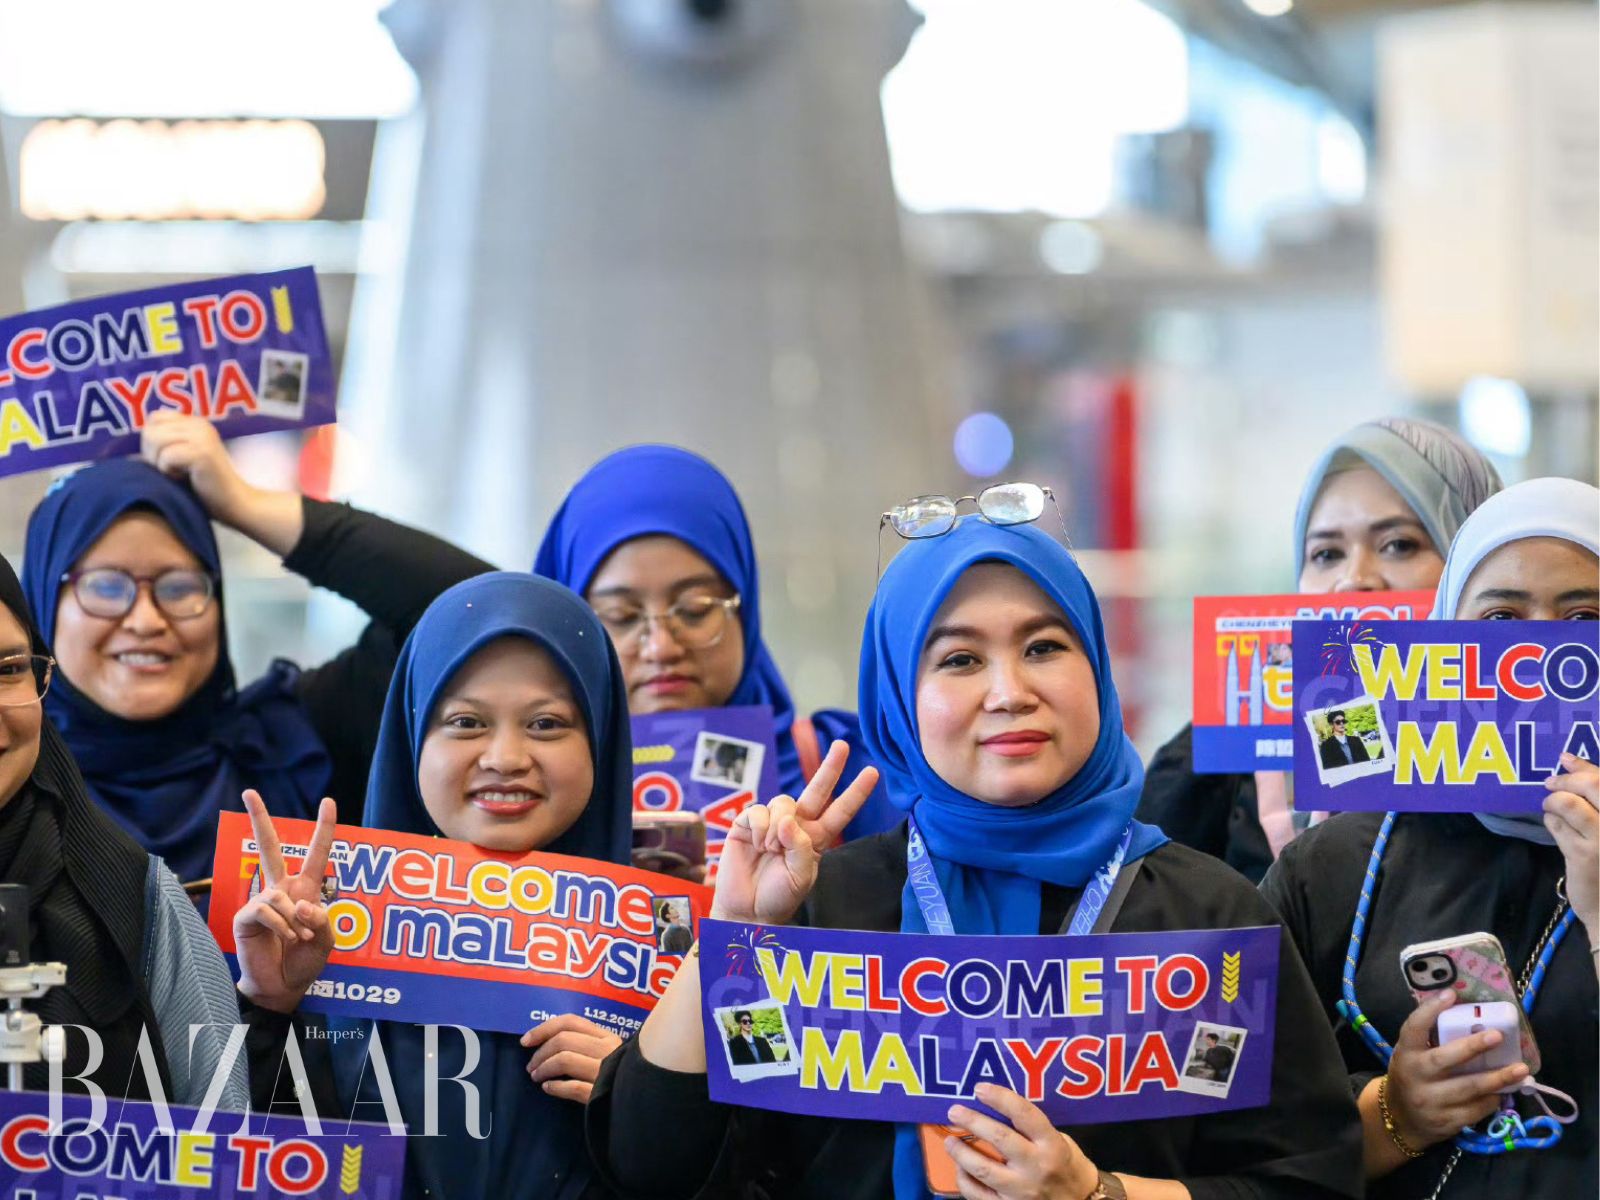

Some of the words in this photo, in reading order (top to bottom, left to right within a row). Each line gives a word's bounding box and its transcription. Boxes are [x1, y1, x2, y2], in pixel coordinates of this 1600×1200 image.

[0, 301, 183, 386] COME
[183, 289, 267, 348] TO
[1351, 643, 1600, 702] WELCO
[755, 947, 1103, 1020] WELCOME
[1115, 953, 1210, 1015] TO
[800, 1026, 1181, 1102] MALAYSIA
[0, 1113, 215, 1188] COME
[227, 1135, 328, 1196] TO
